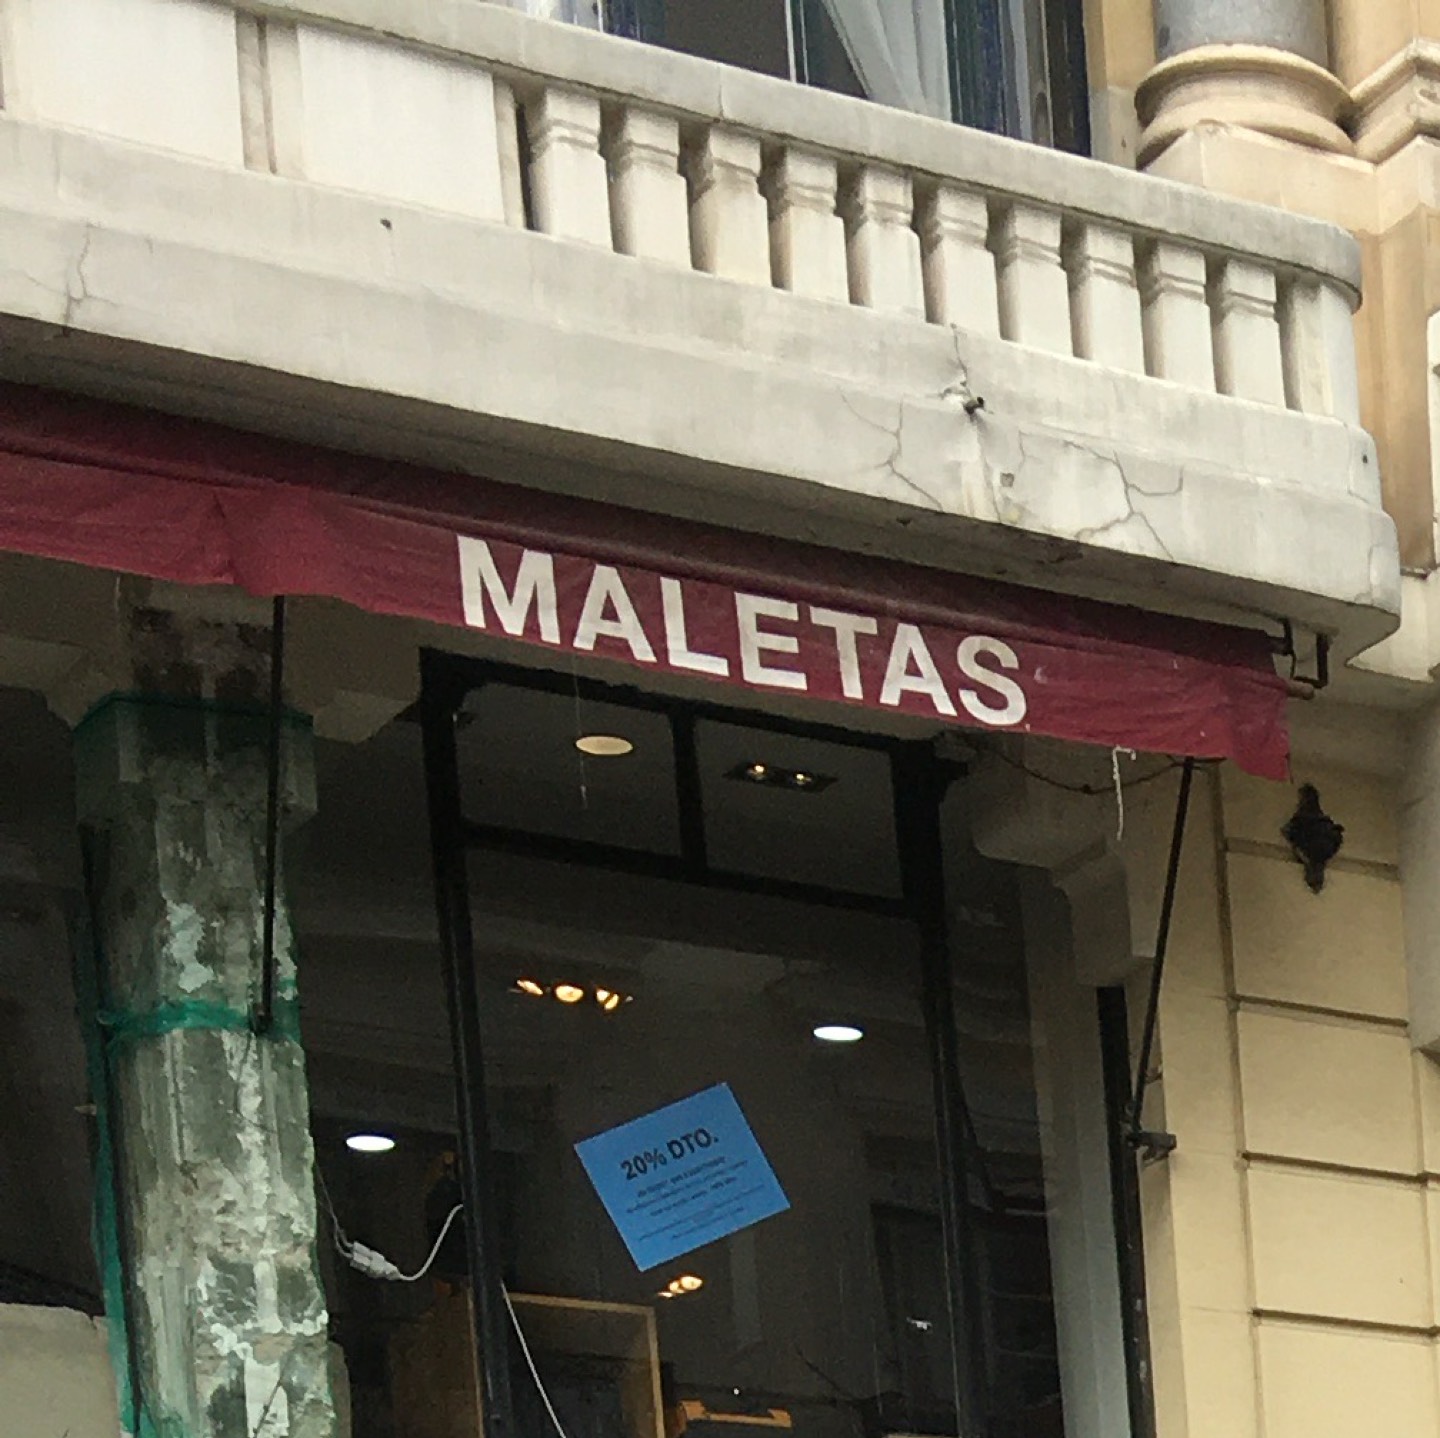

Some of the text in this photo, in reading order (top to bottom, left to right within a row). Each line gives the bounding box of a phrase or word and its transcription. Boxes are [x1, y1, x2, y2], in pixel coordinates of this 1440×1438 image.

[456, 534, 1028, 726] MALETAS
[620, 1128, 719, 1180] 20% DTO.
